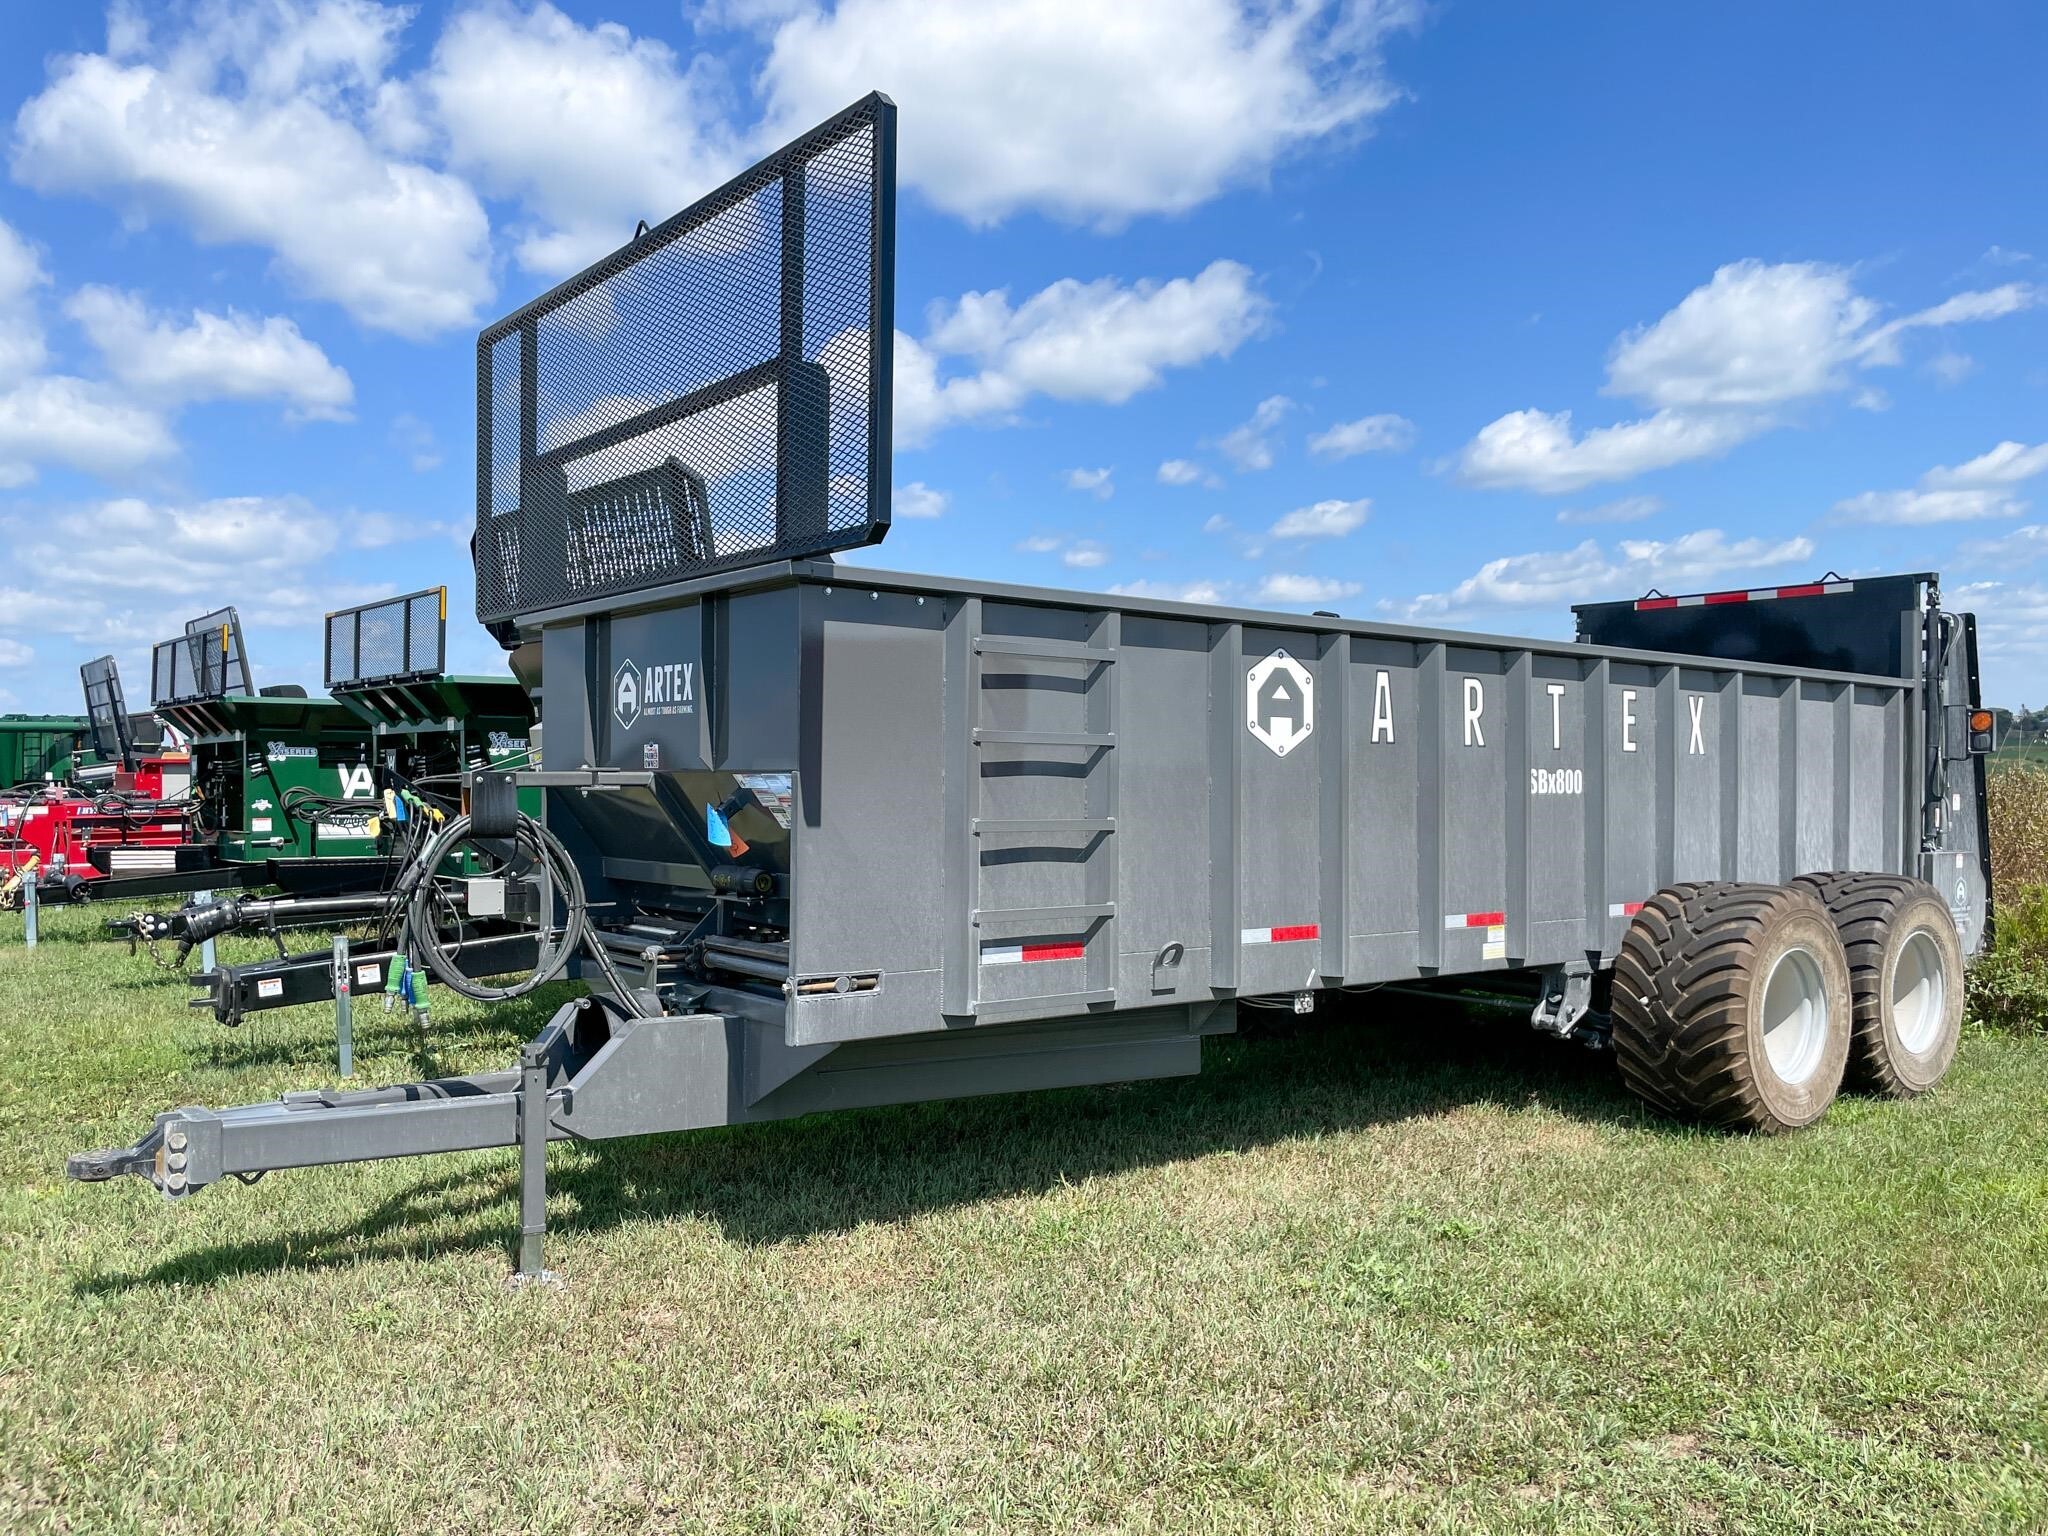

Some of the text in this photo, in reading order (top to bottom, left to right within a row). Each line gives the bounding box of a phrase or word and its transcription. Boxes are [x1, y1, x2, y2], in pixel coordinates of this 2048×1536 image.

[644, 663, 693, 703] ARTEX
[643, 707, 656, 716] ALMOST
[661, 706, 672, 715] TOUGH
[1530, 768, 1582, 794] SBx800
